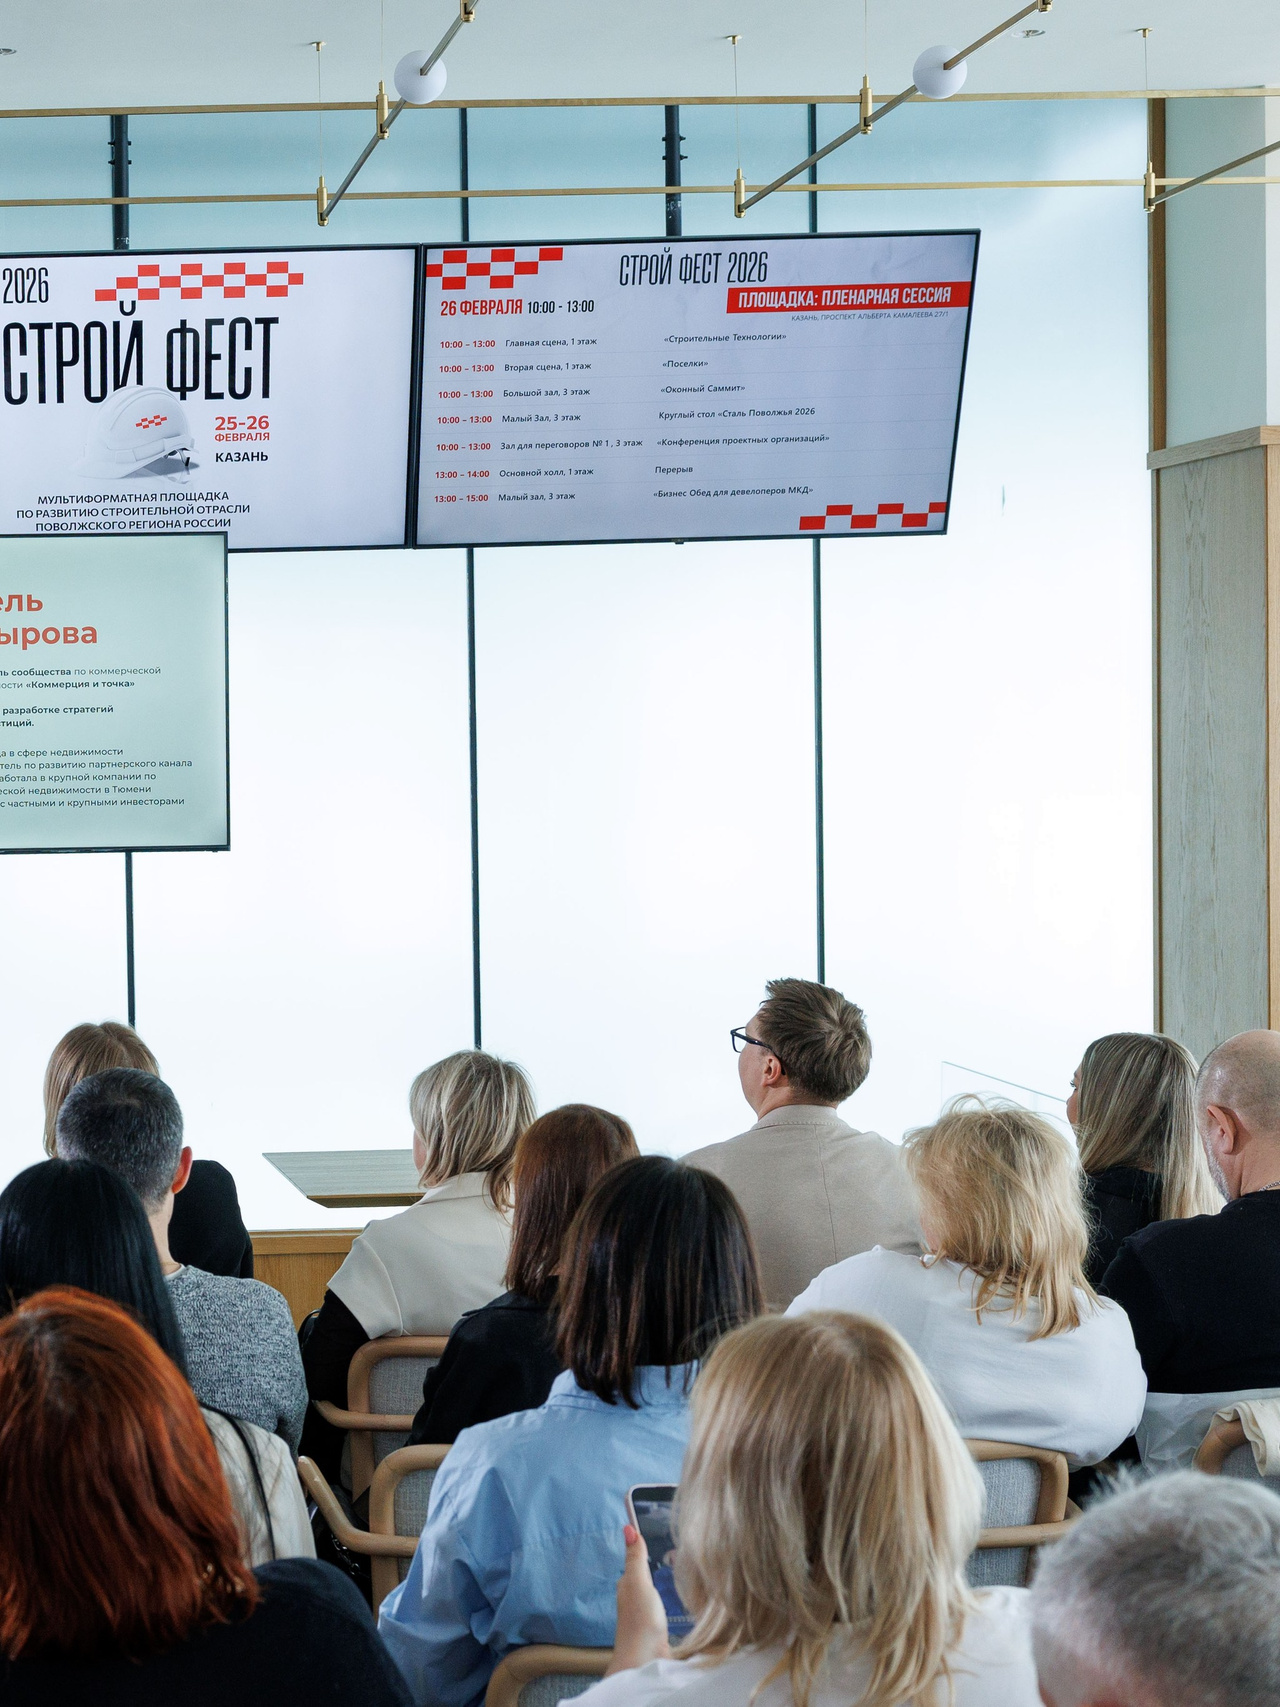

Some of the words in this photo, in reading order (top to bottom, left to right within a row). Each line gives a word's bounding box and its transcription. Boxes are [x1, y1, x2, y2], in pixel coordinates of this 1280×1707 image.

[619, 246, 672, 286] СТРОЙ
[679, 252, 722, 284] ФЕСТ
[727, 251, 769, 283] 2026
[2, 267, 48, 303] 2026
[738, 290, 819, 309] ПЛОЩАДКА:
[821, 288, 900, 306] ПЛЕНАРНАЯ
[902, 286, 952, 304] СЕССИЯ
[440, 300, 457, 317] 26
[459, 298, 523, 316] ФЕВРАЛЯ
[527, 300, 556, 314] 10:00
[567, 299, 595, 314] 13:00
[791, 314, 820, 322] КАЗАНЬ,
[820, 313, 857, 321] ПРОСПЕКТ
[857, 312, 892, 320] АЛЬБЕРТА
[893, 311, 934, 319] КАМАЛЕЕВА
[934, 310, 949, 318] 27/1
[663, 334, 730, 345] «Строительные
[732, 333, 787, 342] Технологии»
[2, 299, 144, 405] СТРОЙ
[166, 316, 279, 400] ФЕСТ
[662, 360, 709, 368] «Поселки»
[660, 384, 705, 394] «Оконный
[707, 384, 746, 393] Саммит»
[658, 410, 695, 422] Круглый
[696, 411, 716, 419] стол
[717, 409, 747, 418] «Сталь
[748, 409, 793, 417] Поволжья
[794, 407, 816, 416] 2026
[214, 415, 270, 431] 25-26
[214, 432, 270, 443] ФЕВРАЛЯ
[656, 438, 721, 448] «Конференция
[722, 437, 769, 446] проектных
[770, 433, 830, 445] организаций»
[215, 451, 269, 463] КАЗАНЬ
[654, 466, 694, 476] Перерыв
[653, 490, 687, 498] «Бизнес
[689, 488, 712, 498] Обед
[712, 489, 729, 498] для
[729, 488, 786, 497] девелоперов
[787, 485, 814, 496] МКД»
[37, 493, 158, 505] МУЛЬТИФОРМАТНАЯ
[159, 491, 230, 503] ПЛОЩАДКА
[16, 509, 34, 519] ПО
[35, 508, 100, 519] РАЗВИТИЮ
[101, 503, 195, 517] СТРОИТЕЛЬНОЙ
[196, 504, 251, 515] ОТРАСЛИ
[35, 520, 127, 532] ПОВОЛЖСКОГО
[128, 519, 182, 530] РЕГИОНА
[183, 518, 231, 529] РОССИИ
[11, 667, 72, 677] сообщества
[88, 666, 161, 677] коммерческой
[25, 680, 90, 690] «Коммерция
[2, 705, 61, 717] разработке
[62, 704, 114, 716] стратегий
[9, 750, 15, 758] в
[17, 749, 48, 759] сфере
[50, 749, 124, 758] недвижимости
[24, 762, 37, 770] по
[38, 762, 87, 771] развитию
[88, 760, 157, 770] партнерского
[158, 760, 193, 768] канала
[48, 773, 90, 784] крупной
[144, 773, 157, 781] по
[28, 787, 102, 796] недвижимости
[112, 785, 152, 794] Тюмени
[7, 800, 56, 808] частными
[67, 799, 118, 809] крупными
[120, 798, 185, 807] инвесторами
